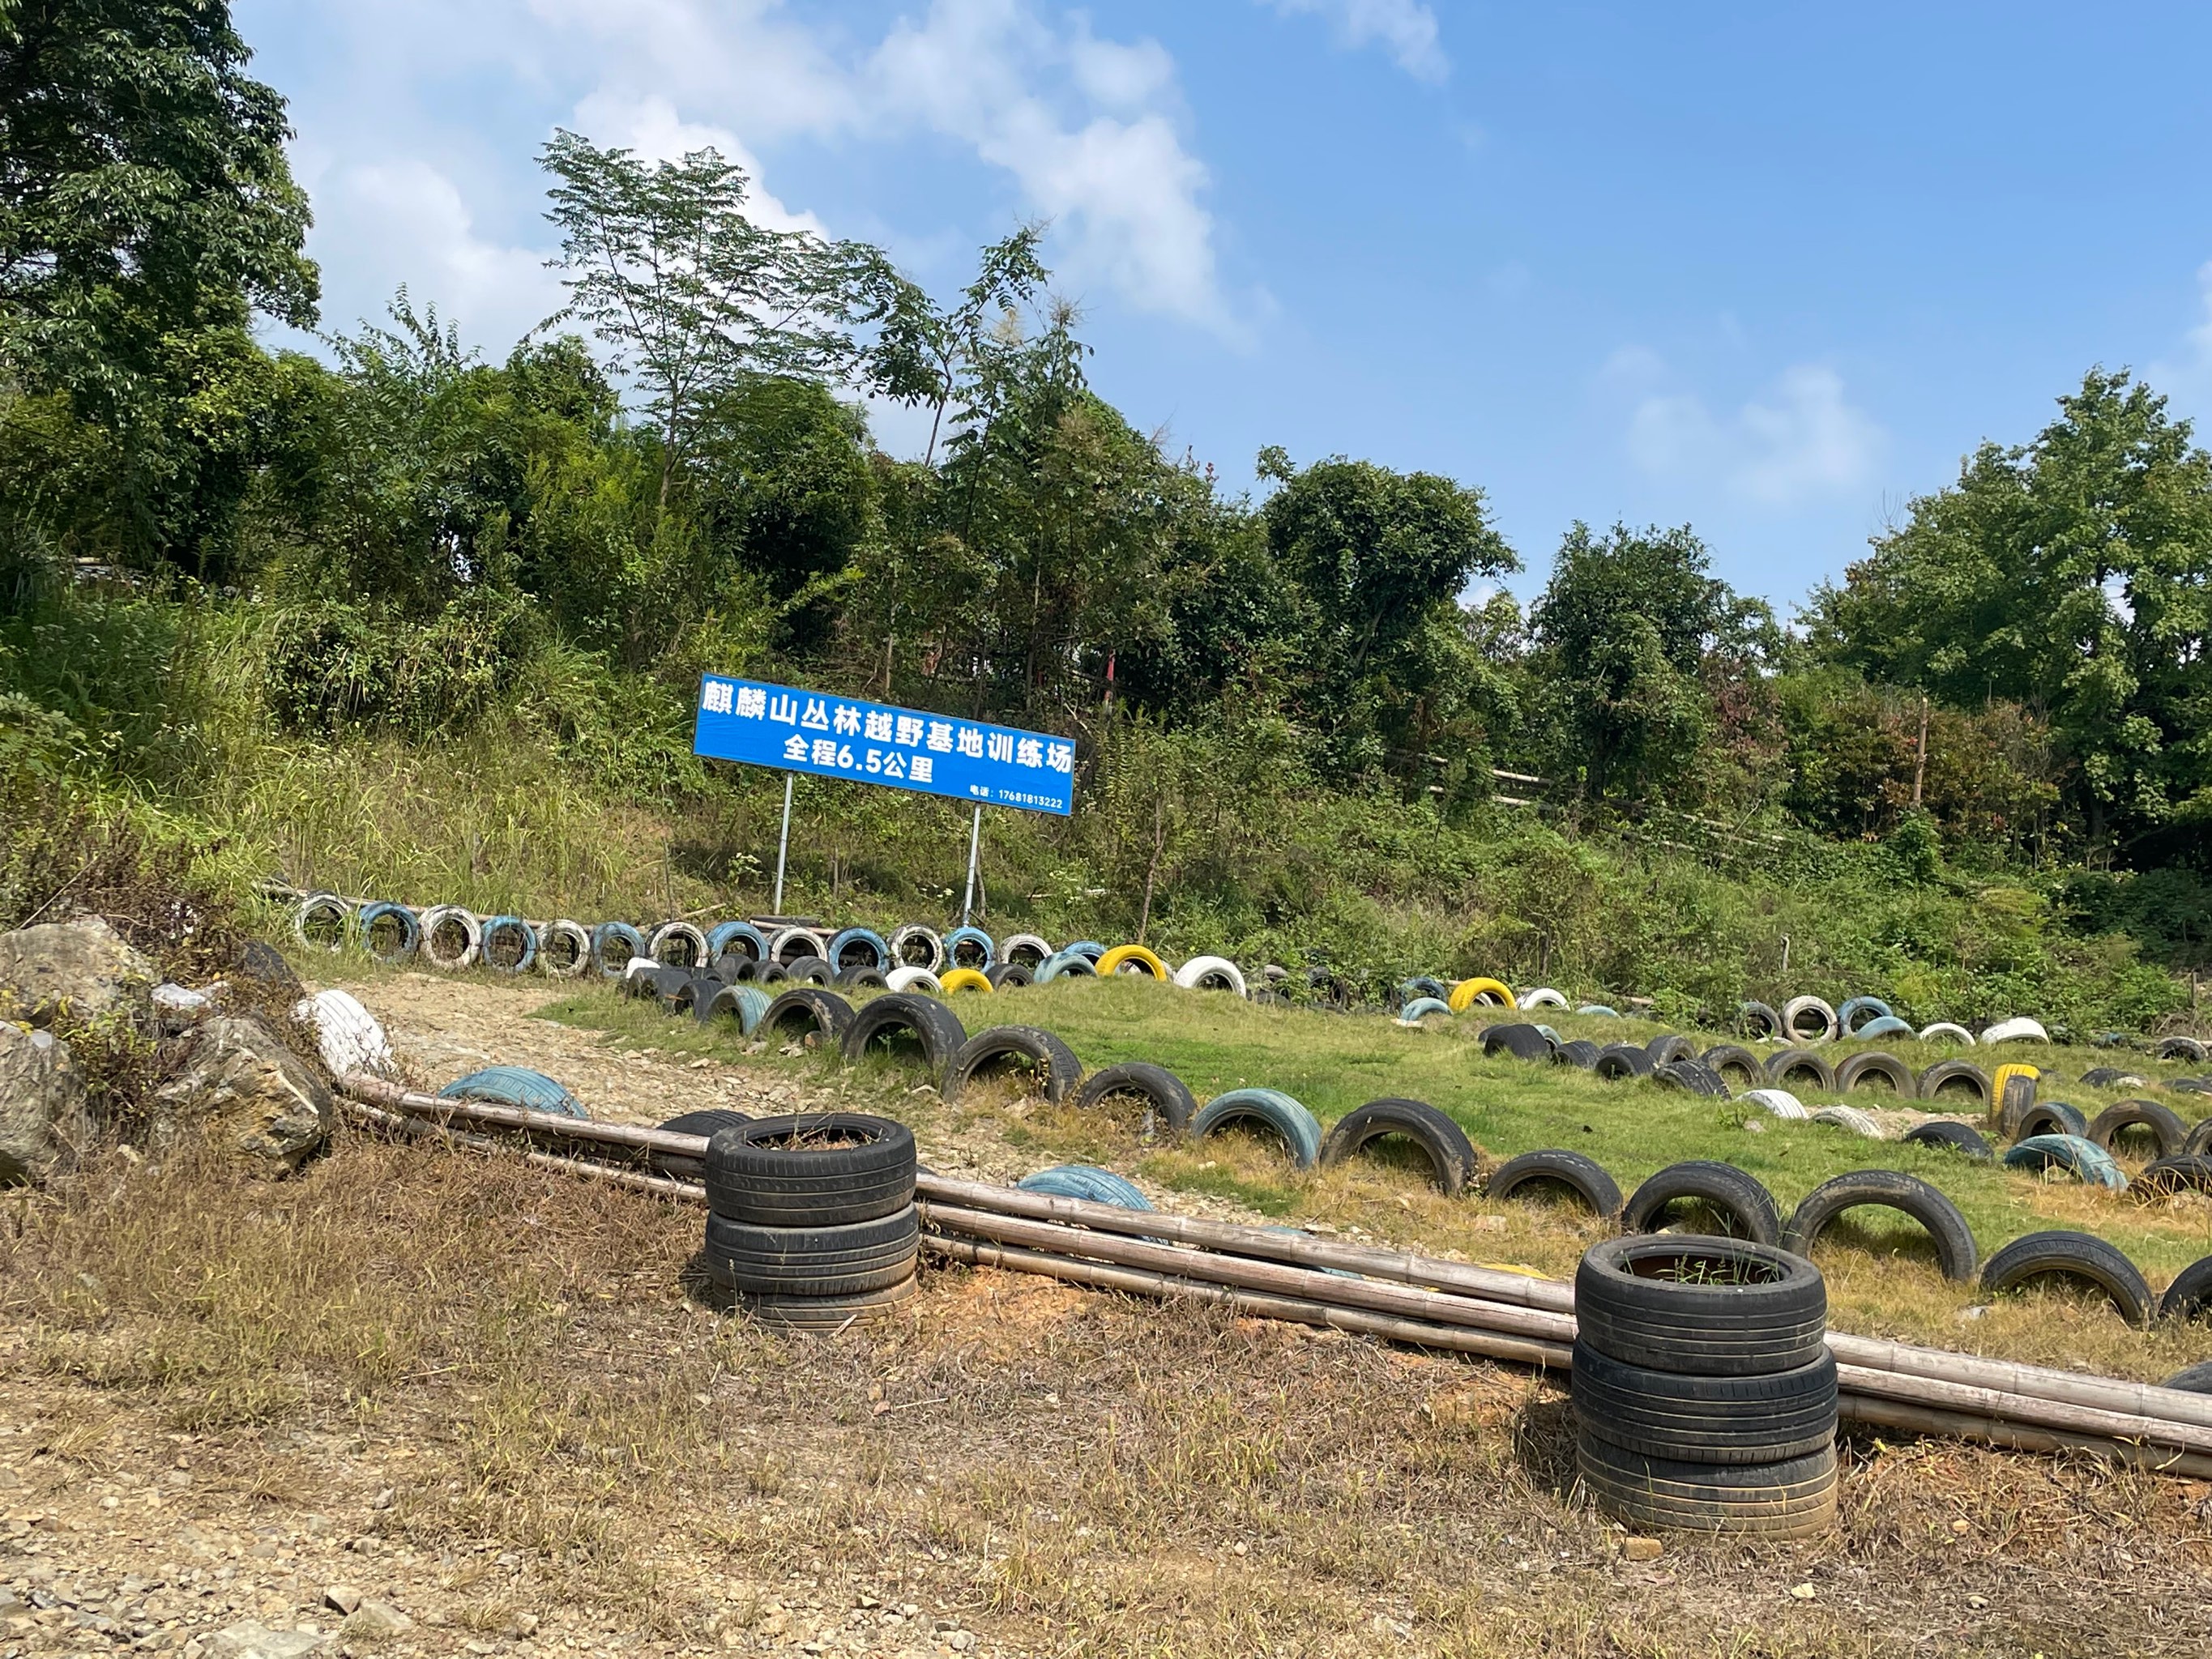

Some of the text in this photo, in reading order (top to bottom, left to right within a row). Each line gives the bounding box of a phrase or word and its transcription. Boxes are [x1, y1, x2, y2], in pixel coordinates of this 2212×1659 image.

[702, 680, 1073, 773] 麒麟山丛林越野基地训练场
[783, 733, 933, 783] 全程6.5公里
[998, 789, 1063, 809] 17681813222
